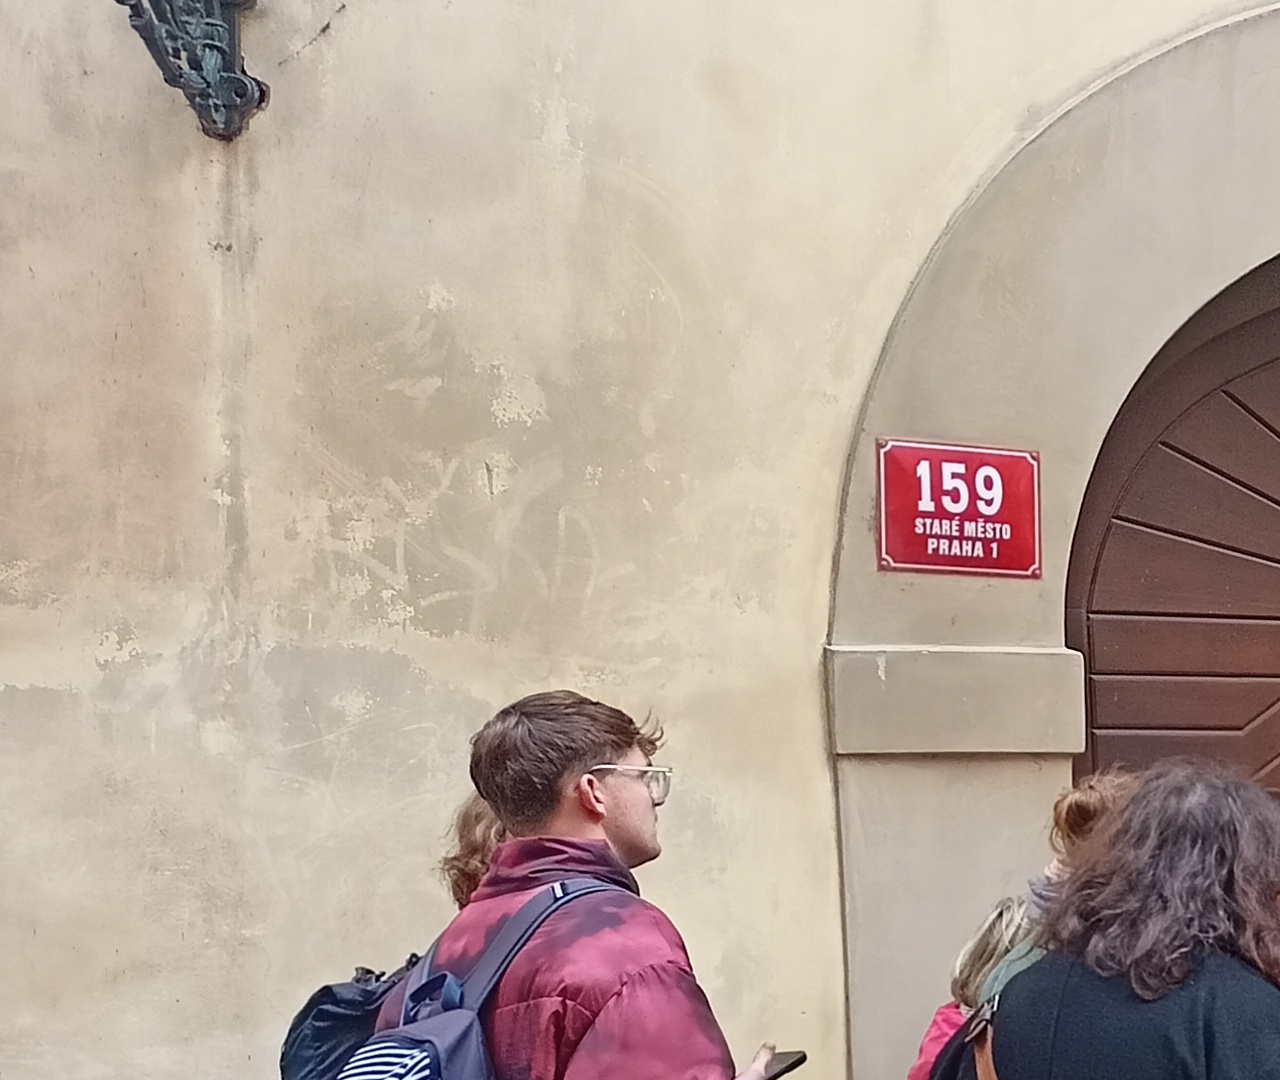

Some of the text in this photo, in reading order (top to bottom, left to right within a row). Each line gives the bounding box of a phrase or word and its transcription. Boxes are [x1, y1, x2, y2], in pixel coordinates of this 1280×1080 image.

[916, 460, 1003, 516] 159
[914, 516, 1011, 540] STARÉ MĚSTO
[927, 538, 998, 558] PRAHA 1
